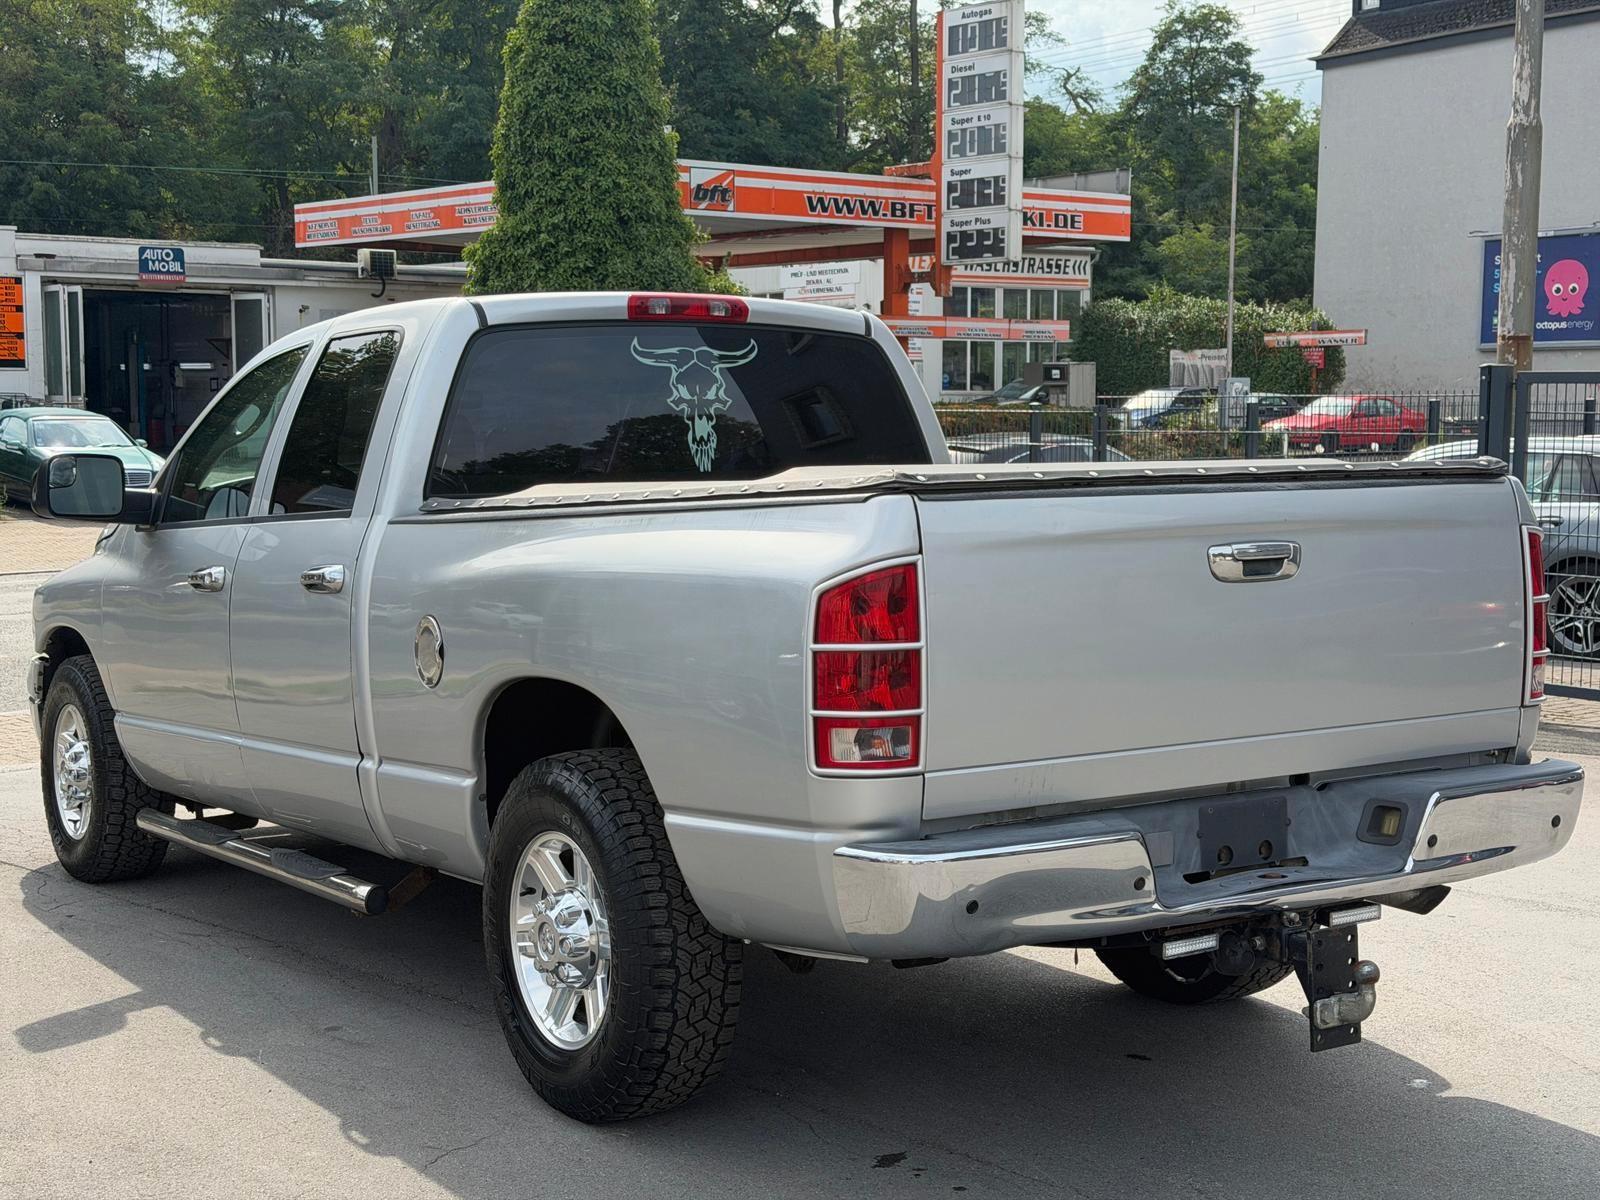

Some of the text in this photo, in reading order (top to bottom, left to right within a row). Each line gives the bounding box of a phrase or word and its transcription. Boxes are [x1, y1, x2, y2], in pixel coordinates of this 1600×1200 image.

[961, 8, 992, 19] Autogas
[951, 62, 975, 74] Diesel
[951, 117, 974, 127] Super
[950, 167, 972, 178] Super
[693, 184, 733, 203] bft
[950, 217, 991, 229] Super Plus
[141, 248, 174, 261] AUTO
[148, 260, 184, 272] MOBIL
[1536, 320, 1594, 331] octopus energy
